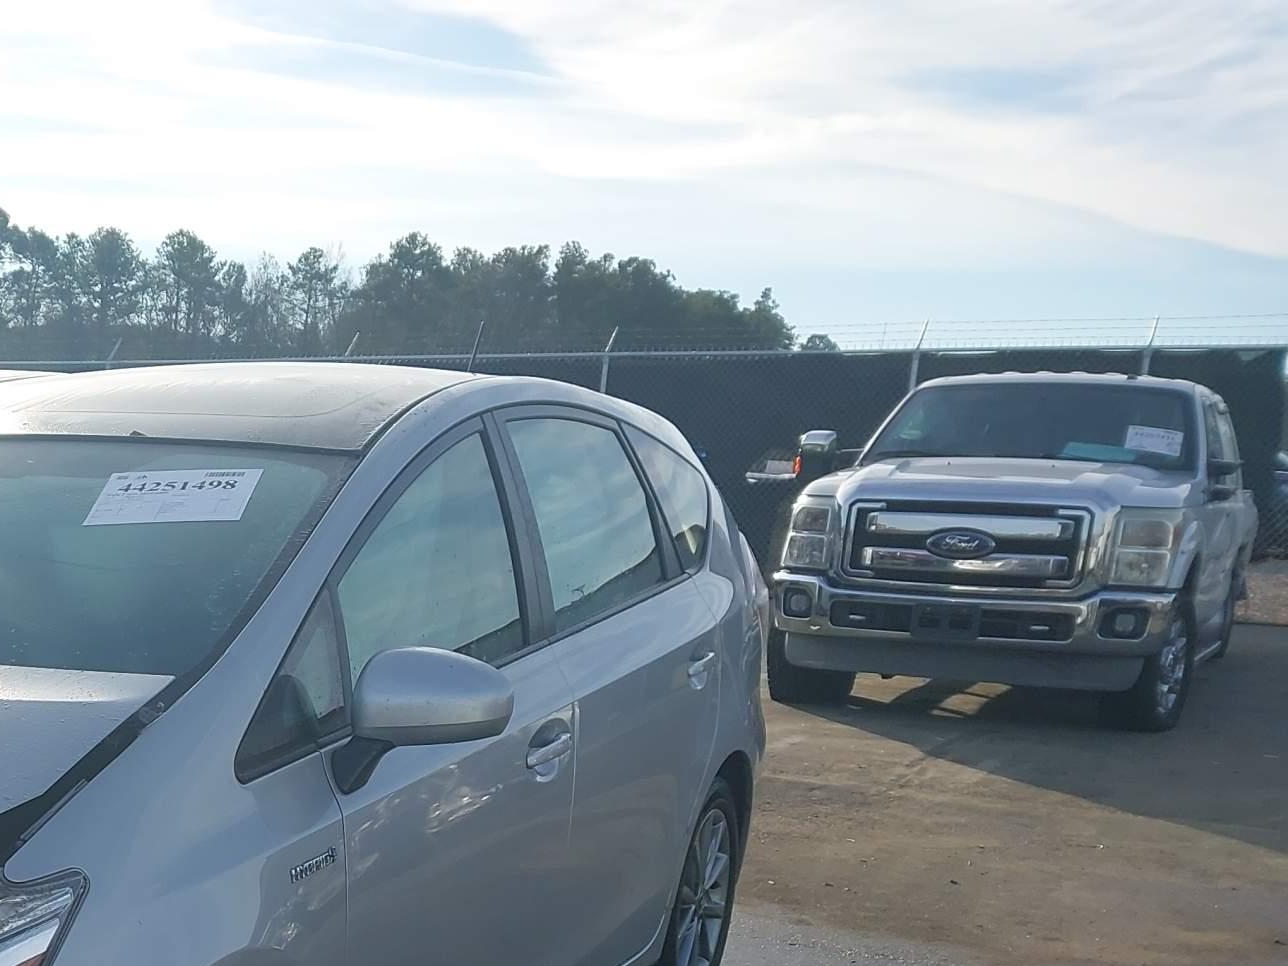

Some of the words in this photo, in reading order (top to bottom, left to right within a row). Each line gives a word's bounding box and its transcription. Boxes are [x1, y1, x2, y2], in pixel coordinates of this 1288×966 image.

[118, 480, 238, 492] 44251498
[941, 535, 980, 551] Ford
[290, 847, 336, 883] HYBRID
